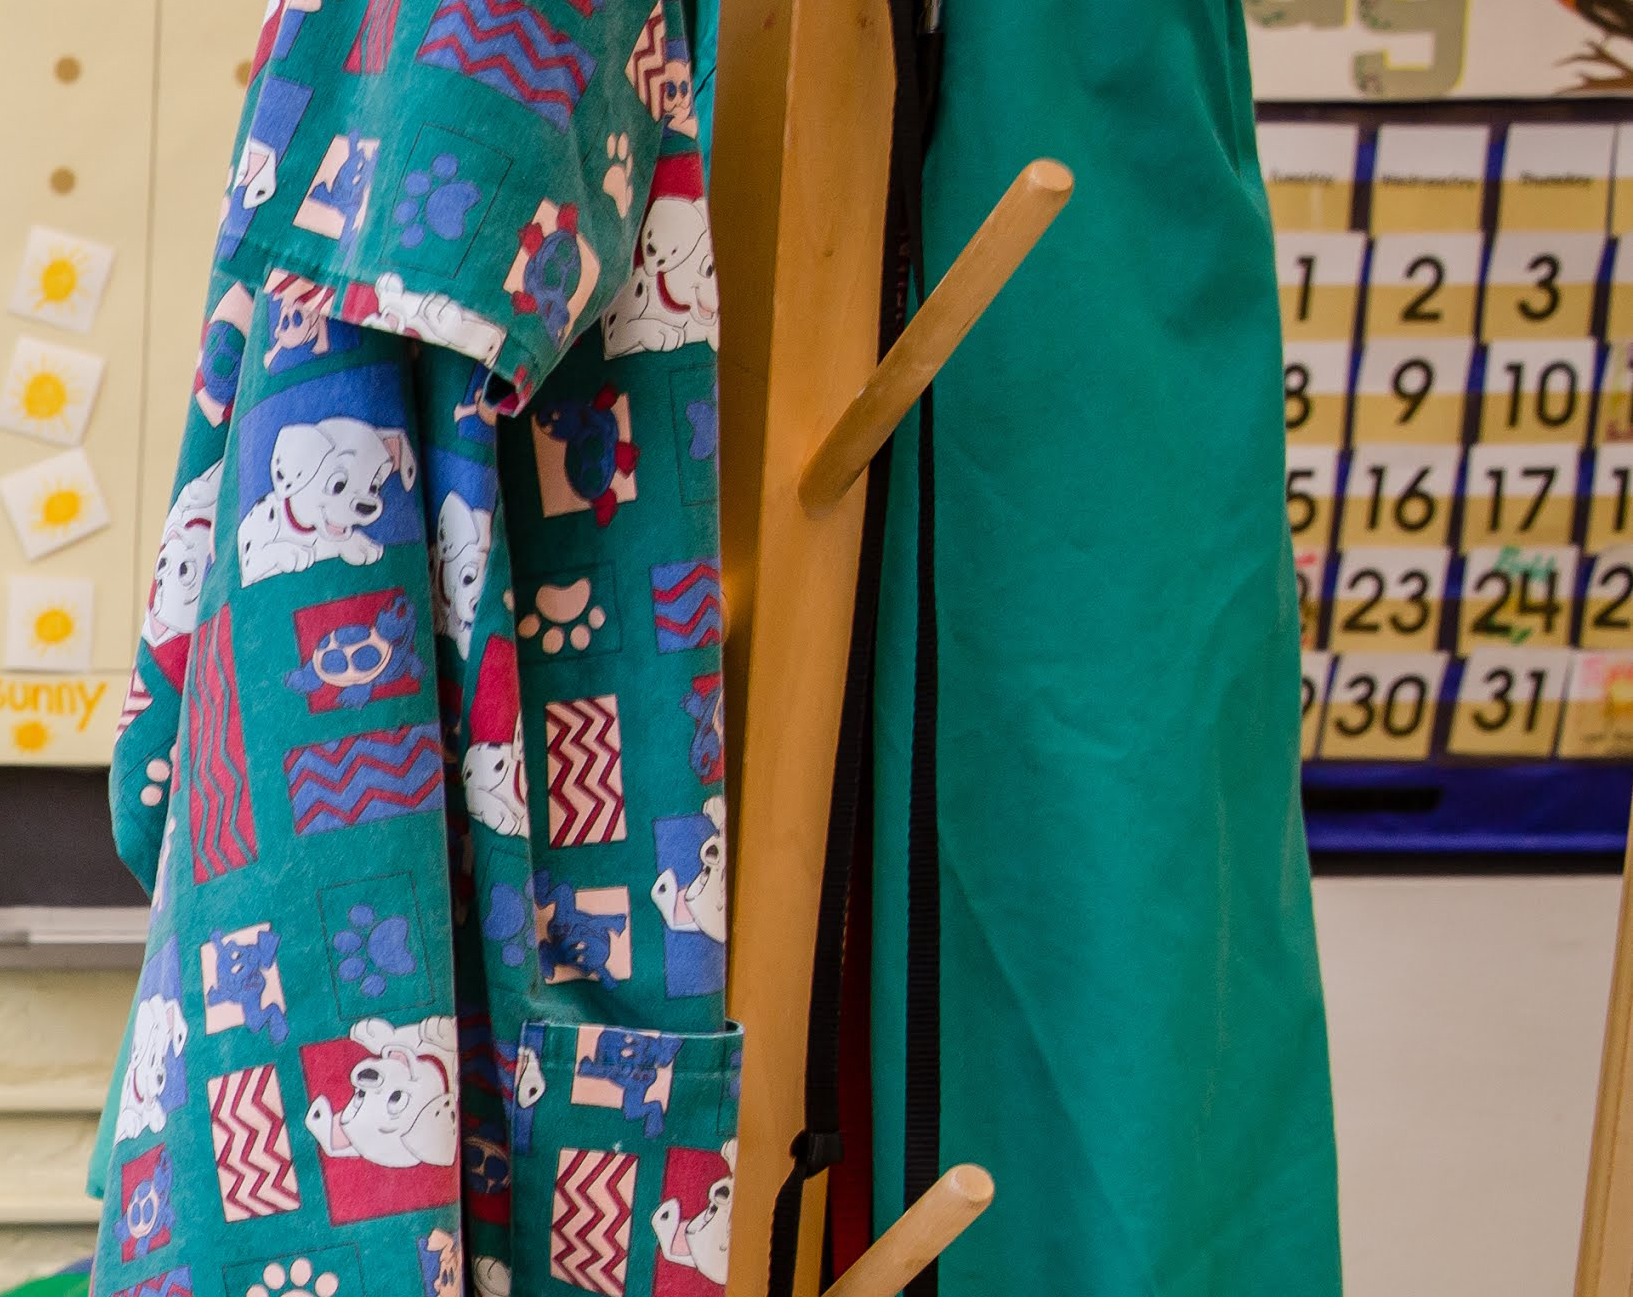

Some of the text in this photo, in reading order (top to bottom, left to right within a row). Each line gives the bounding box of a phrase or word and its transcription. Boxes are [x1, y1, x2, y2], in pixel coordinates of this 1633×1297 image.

[1295, 254, 1316, 322] 1
[1401, 254, 1446, 323] 2
[1516, 253, 1561, 322] 3
[1392, 358, 1435, 425] 9
[1504, 360, 1578, 428] 10
[1286, 468, 1317, 534] 5
[1366, 464, 1436, 533] 16
[1485, 466, 1558, 533] 17
[1342, 567, 1433, 635] 23
[1471, 567, 1562, 635] 24
[1591, 563, 1633, 630] 2
[1334, 673, 1428, 738] 30
[1472, 665, 1548, 734] 31
